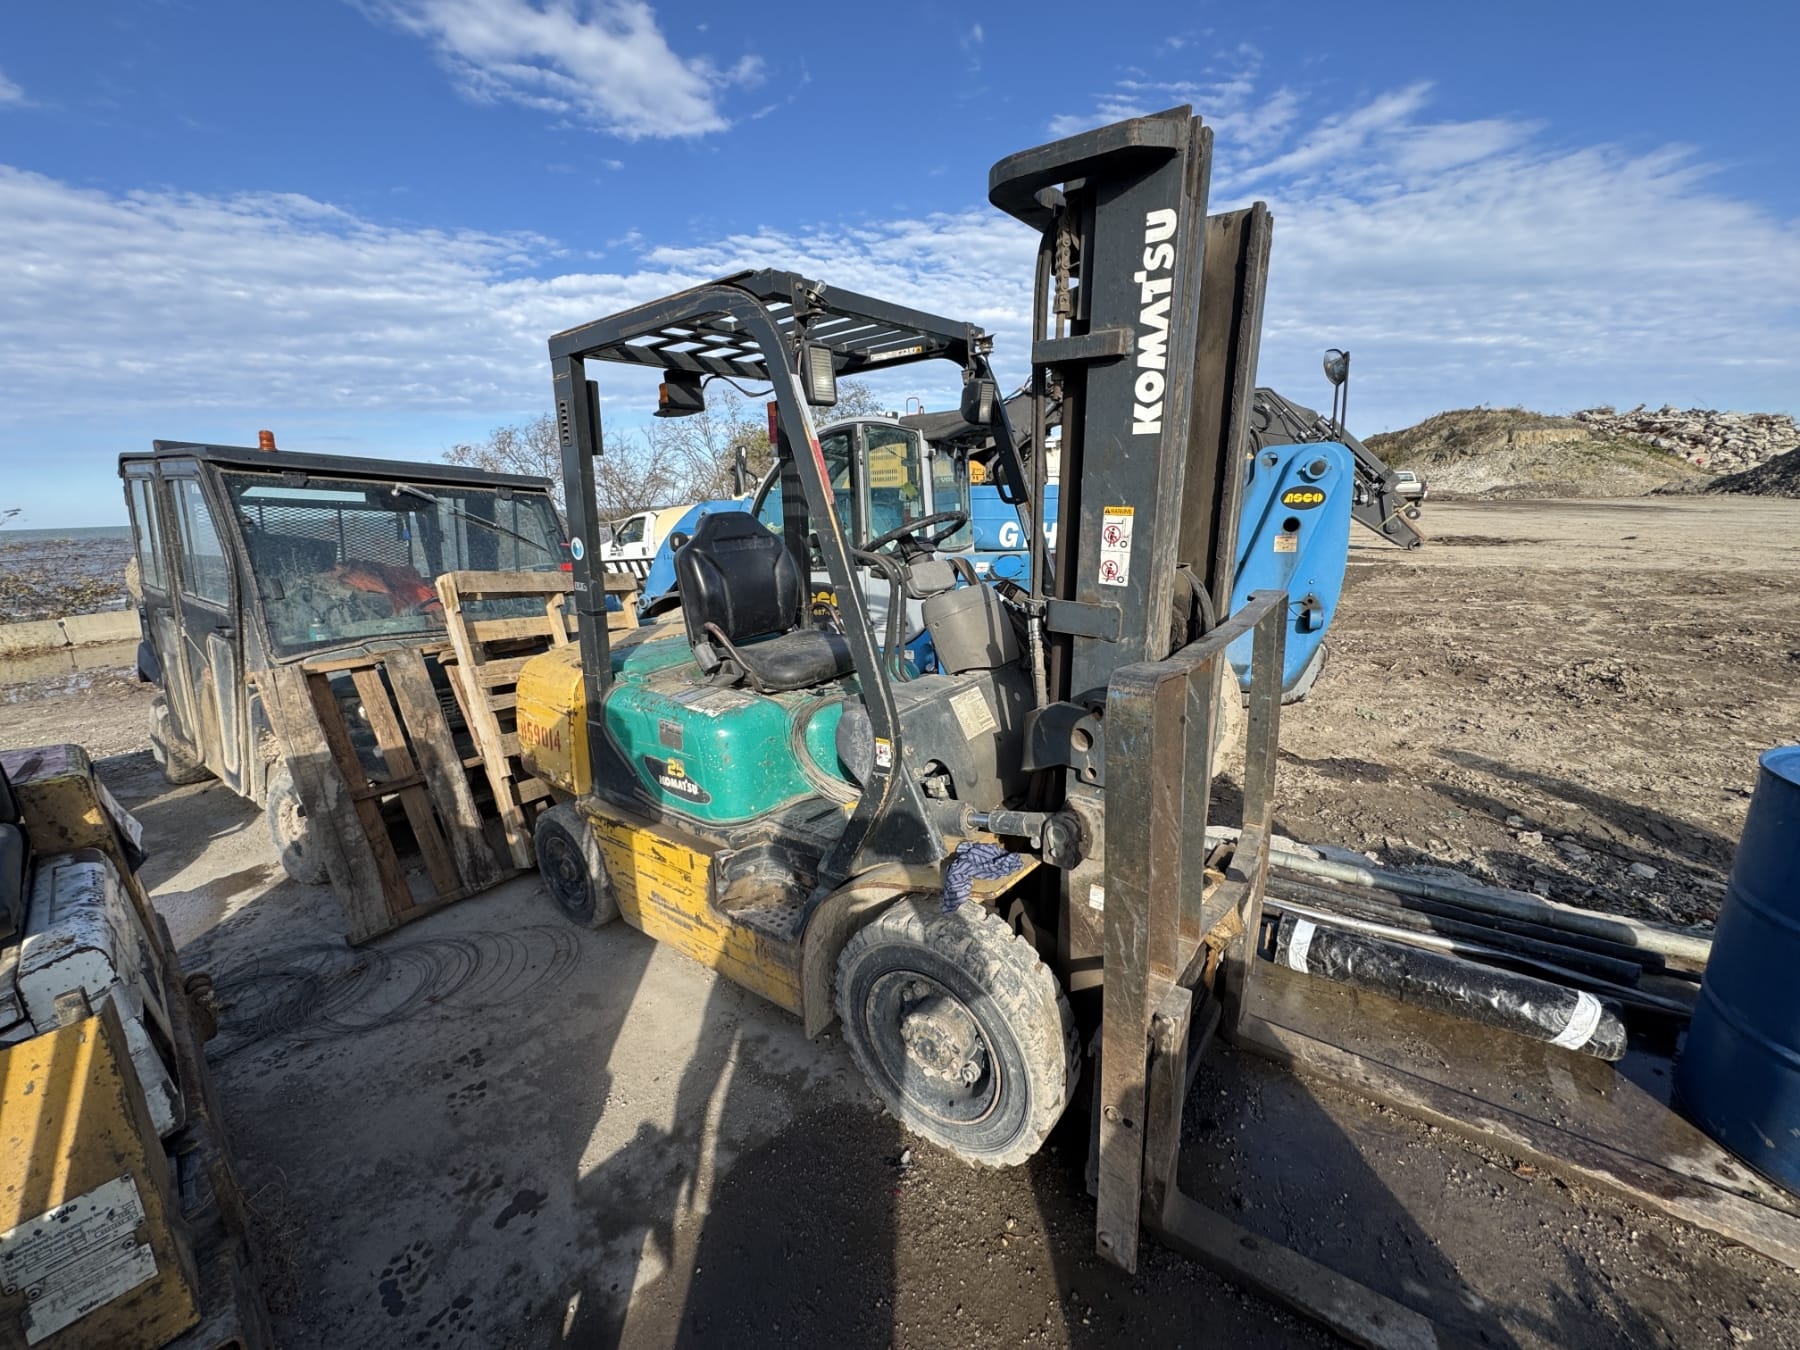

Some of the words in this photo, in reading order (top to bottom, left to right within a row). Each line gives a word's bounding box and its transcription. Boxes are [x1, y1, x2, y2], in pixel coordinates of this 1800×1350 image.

[1132, 208, 1177, 435] KOMATSU
[1283, 492, 1324, 504] ASCO
[999, 521, 1058, 548] GH
[659, 774, 698, 795] KOMATSU
